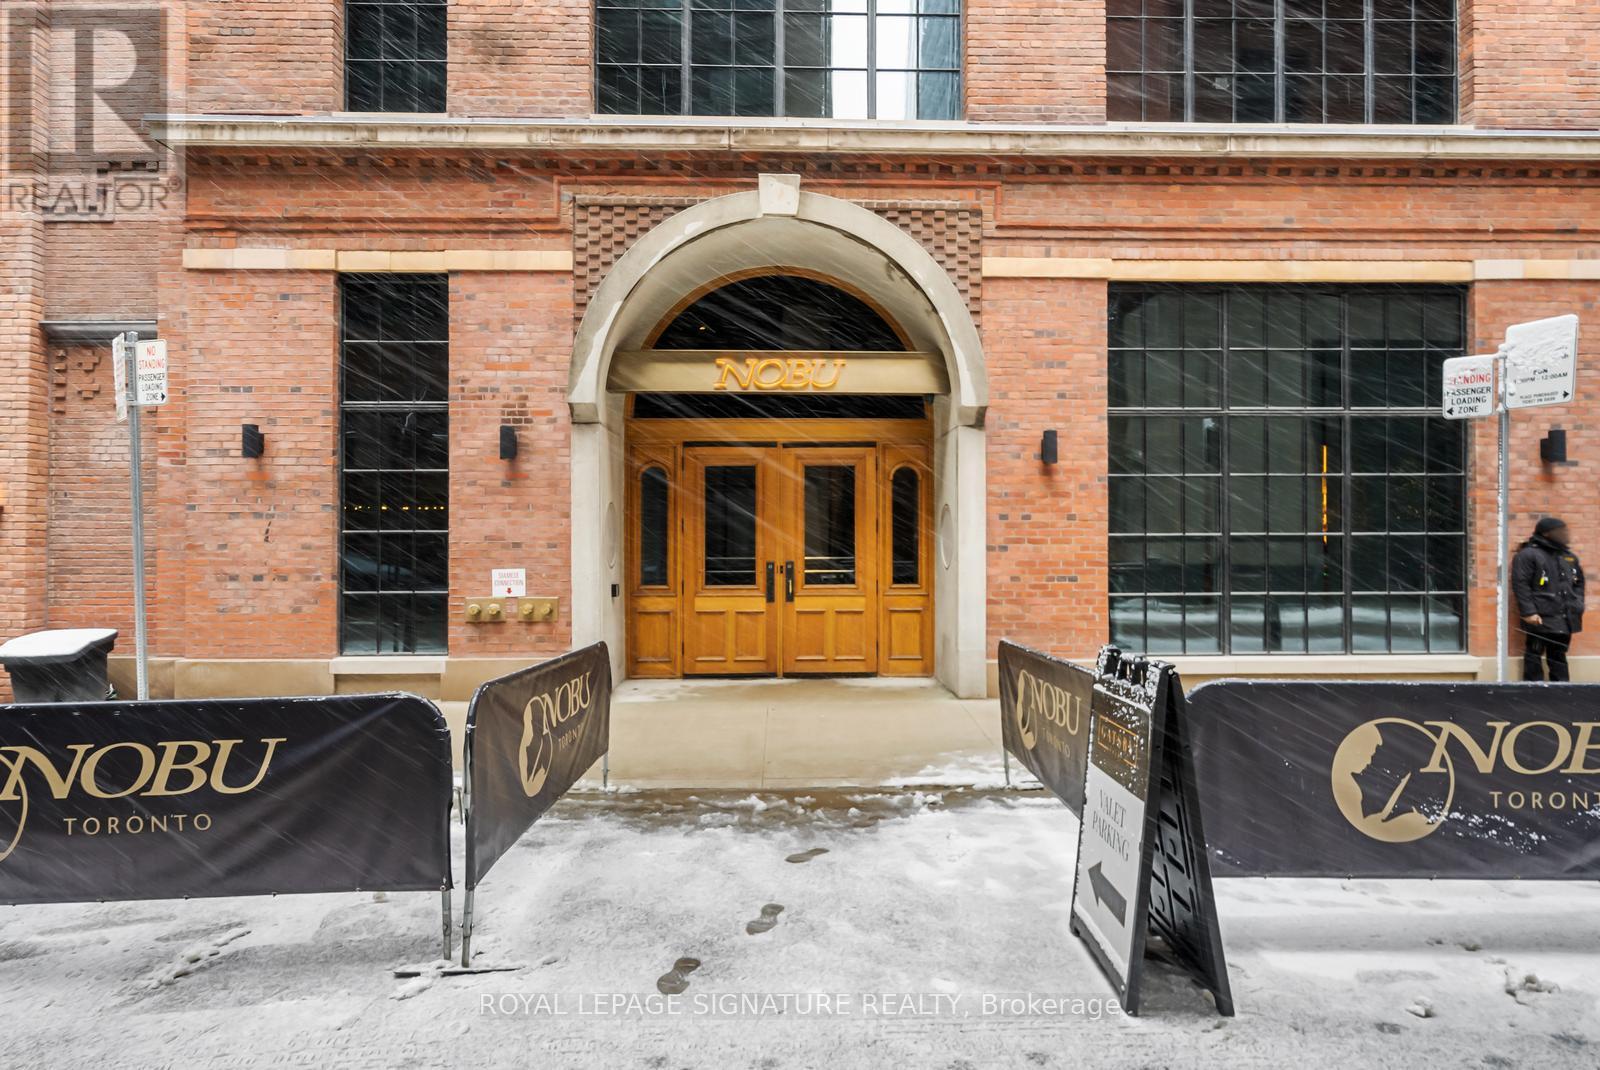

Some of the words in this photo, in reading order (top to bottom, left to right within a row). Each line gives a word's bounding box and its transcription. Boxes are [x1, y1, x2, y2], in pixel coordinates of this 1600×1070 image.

[146, 345, 156, 356] NO
[138, 358, 165, 370] STANDING
[703, 357, 848, 391] NOBU
[138, 373, 165, 382] PASSENGER
[145, 392, 159, 401] ZONE
[1451, 395, 1487, 406] LOADING
[1458, 405, 1479, 415] ZONE
[541, 671, 590, 736] NOBU
[1031, 675, 1082, 735] NOBU
[0, 738, 287, 800] NOBU
[1100, 788, 1127, 828] VALET
[64, 813, 212, 835] TORONTO
[1092, 810, 1129, 862] PARKING
